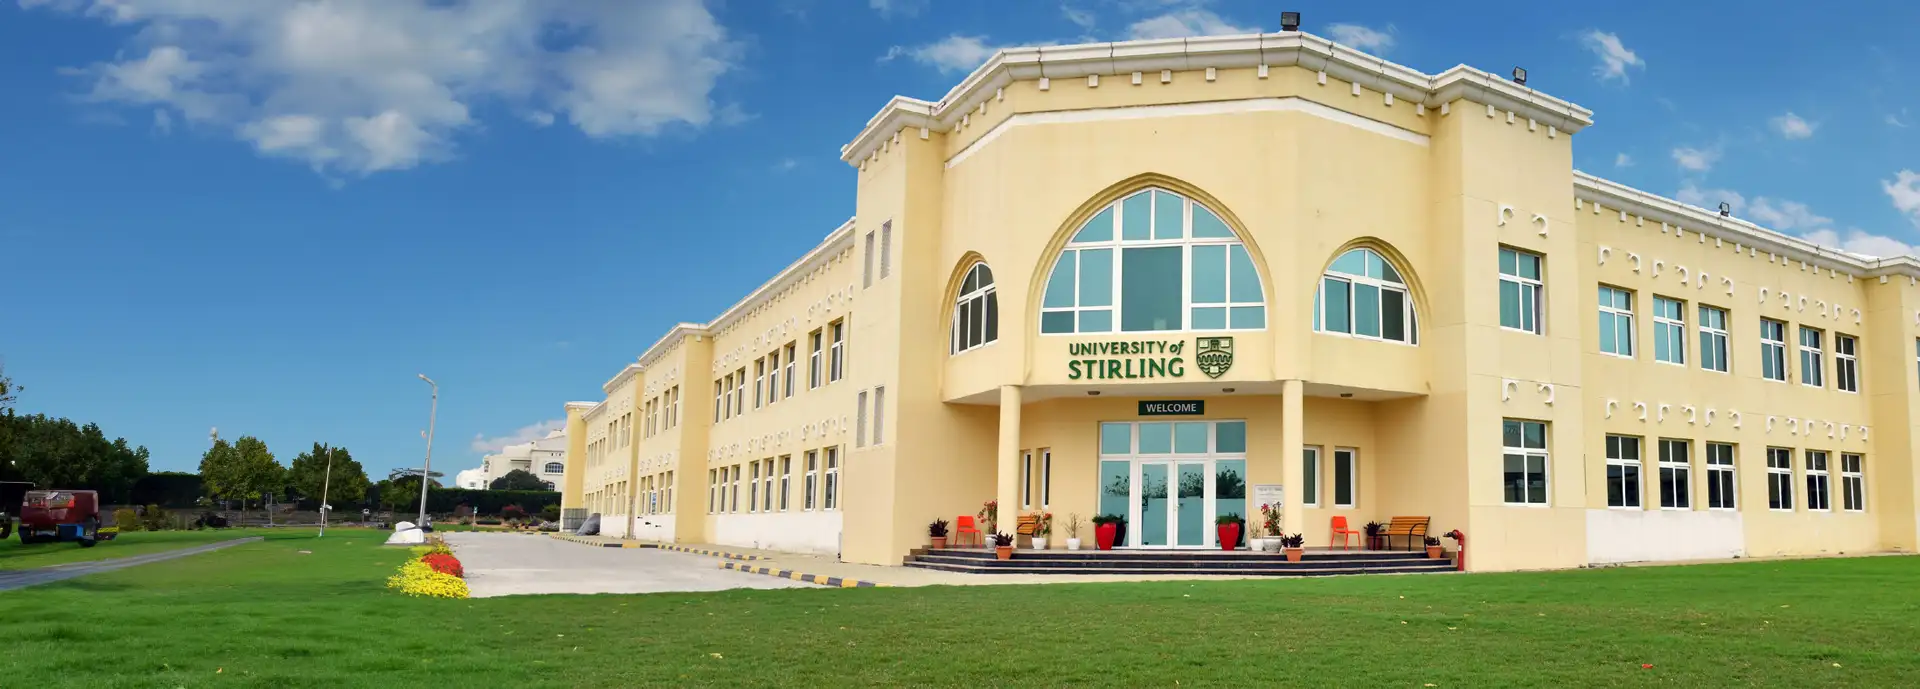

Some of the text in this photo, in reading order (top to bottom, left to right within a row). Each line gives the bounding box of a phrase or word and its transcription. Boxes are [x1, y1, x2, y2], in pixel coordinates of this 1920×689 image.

[1069, 340, 1185, 356] UNIVERSITY of
[1068, 357, 1184, 380] STIRLING
[1146, 403, 1197, 413] WELCOME
